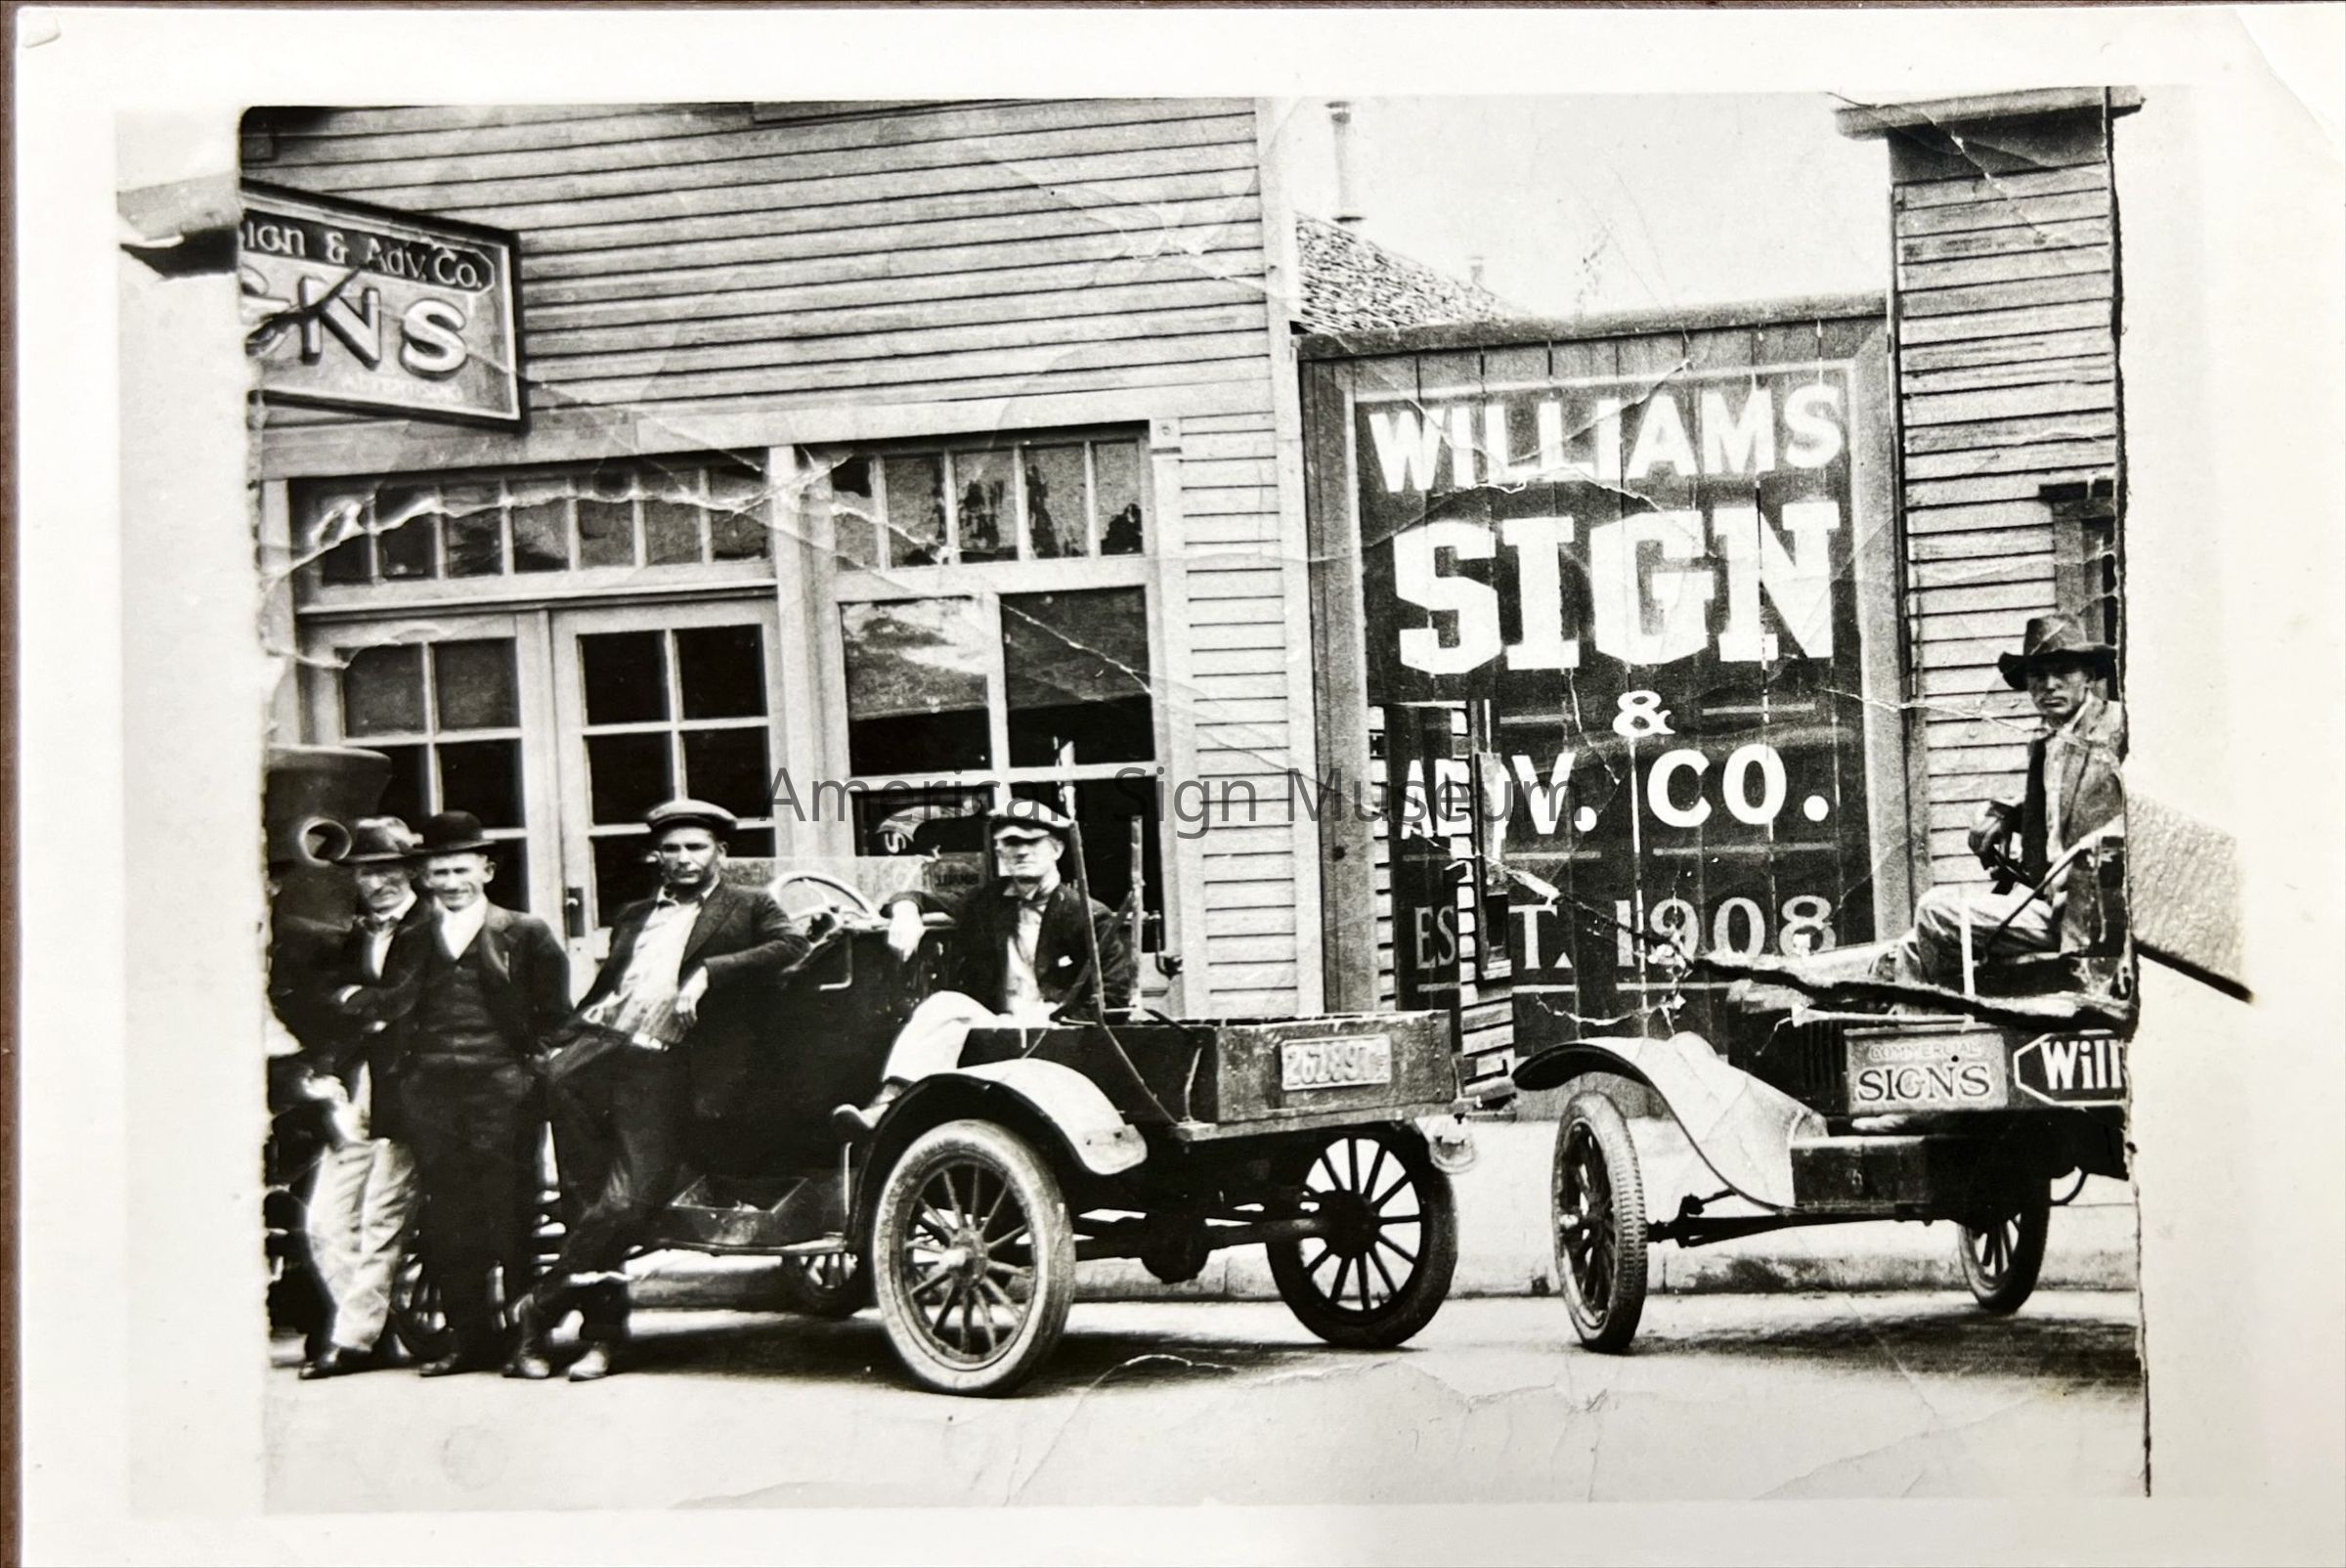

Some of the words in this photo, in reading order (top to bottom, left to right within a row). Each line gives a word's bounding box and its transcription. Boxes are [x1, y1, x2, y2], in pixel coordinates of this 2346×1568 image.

[326, 231, 349, 264] &
[1368, 385, 1844, 493] WILLIAMS
[1394, 501, 1841, 675] SIGN
[1612, 689, 1675, 737] &
[1647, 743, 1830, 828] CO.
[1615, 895, 1838, 968] 1908
[1857, 1065, 1990, 1102] SIGNS
